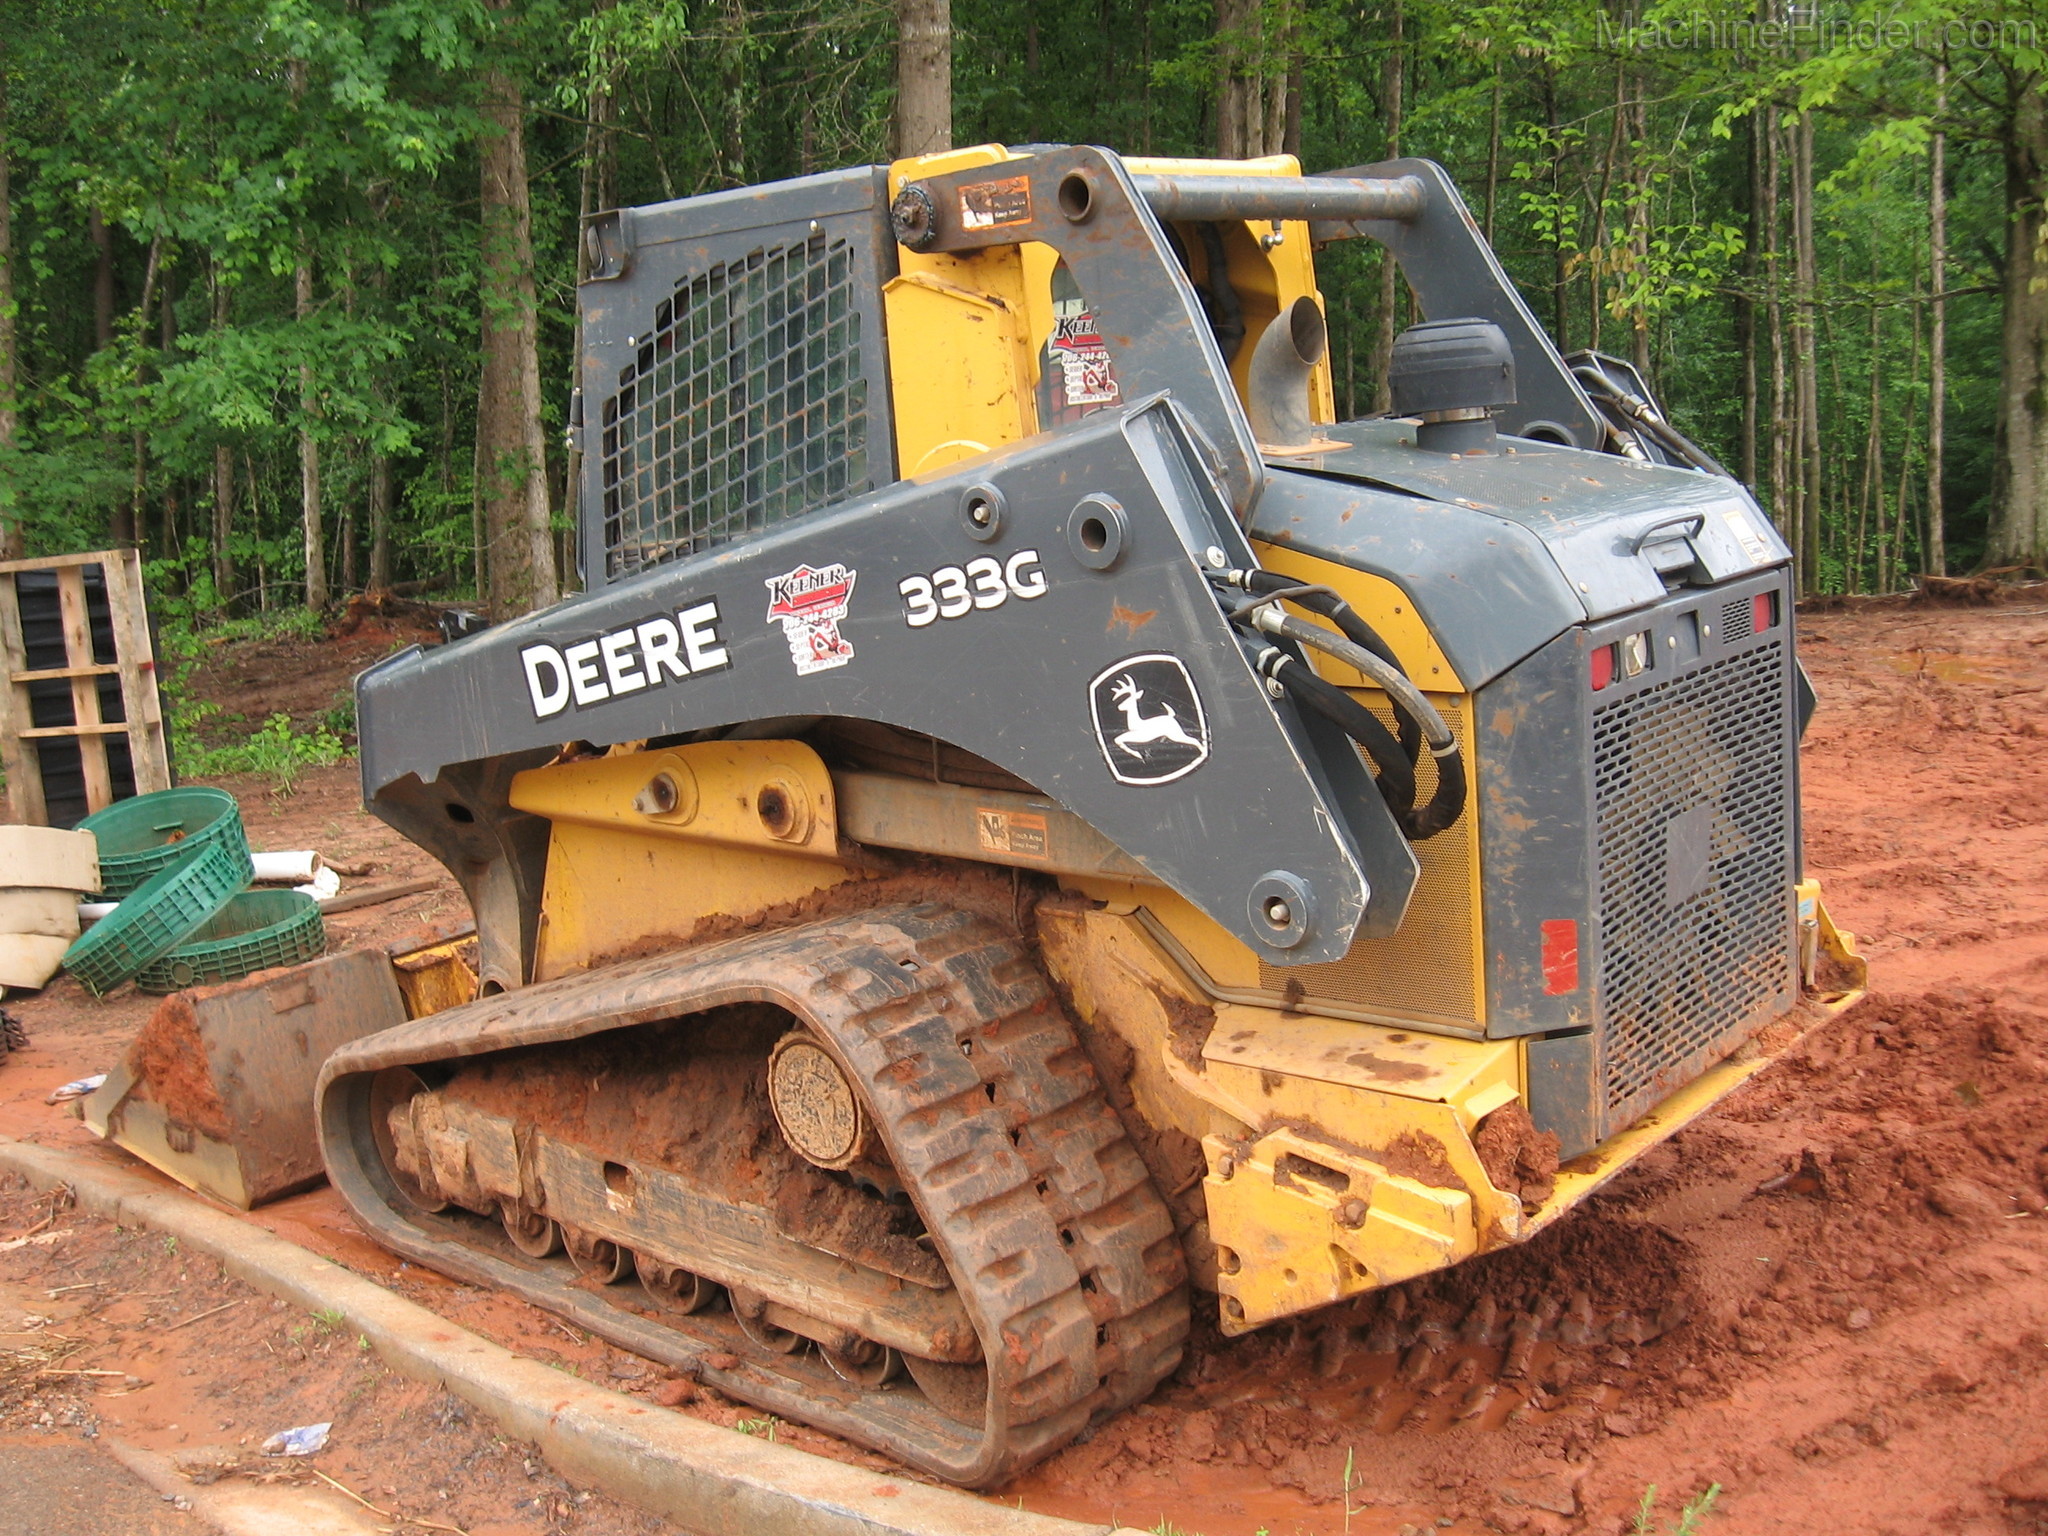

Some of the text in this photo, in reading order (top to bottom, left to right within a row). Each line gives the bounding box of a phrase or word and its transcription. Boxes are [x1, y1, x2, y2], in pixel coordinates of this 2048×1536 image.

[773, 567, 846, 606] KEENER
[899, 550, 1048, 628] 333G
[520, 600, 730, 719] DEERE
